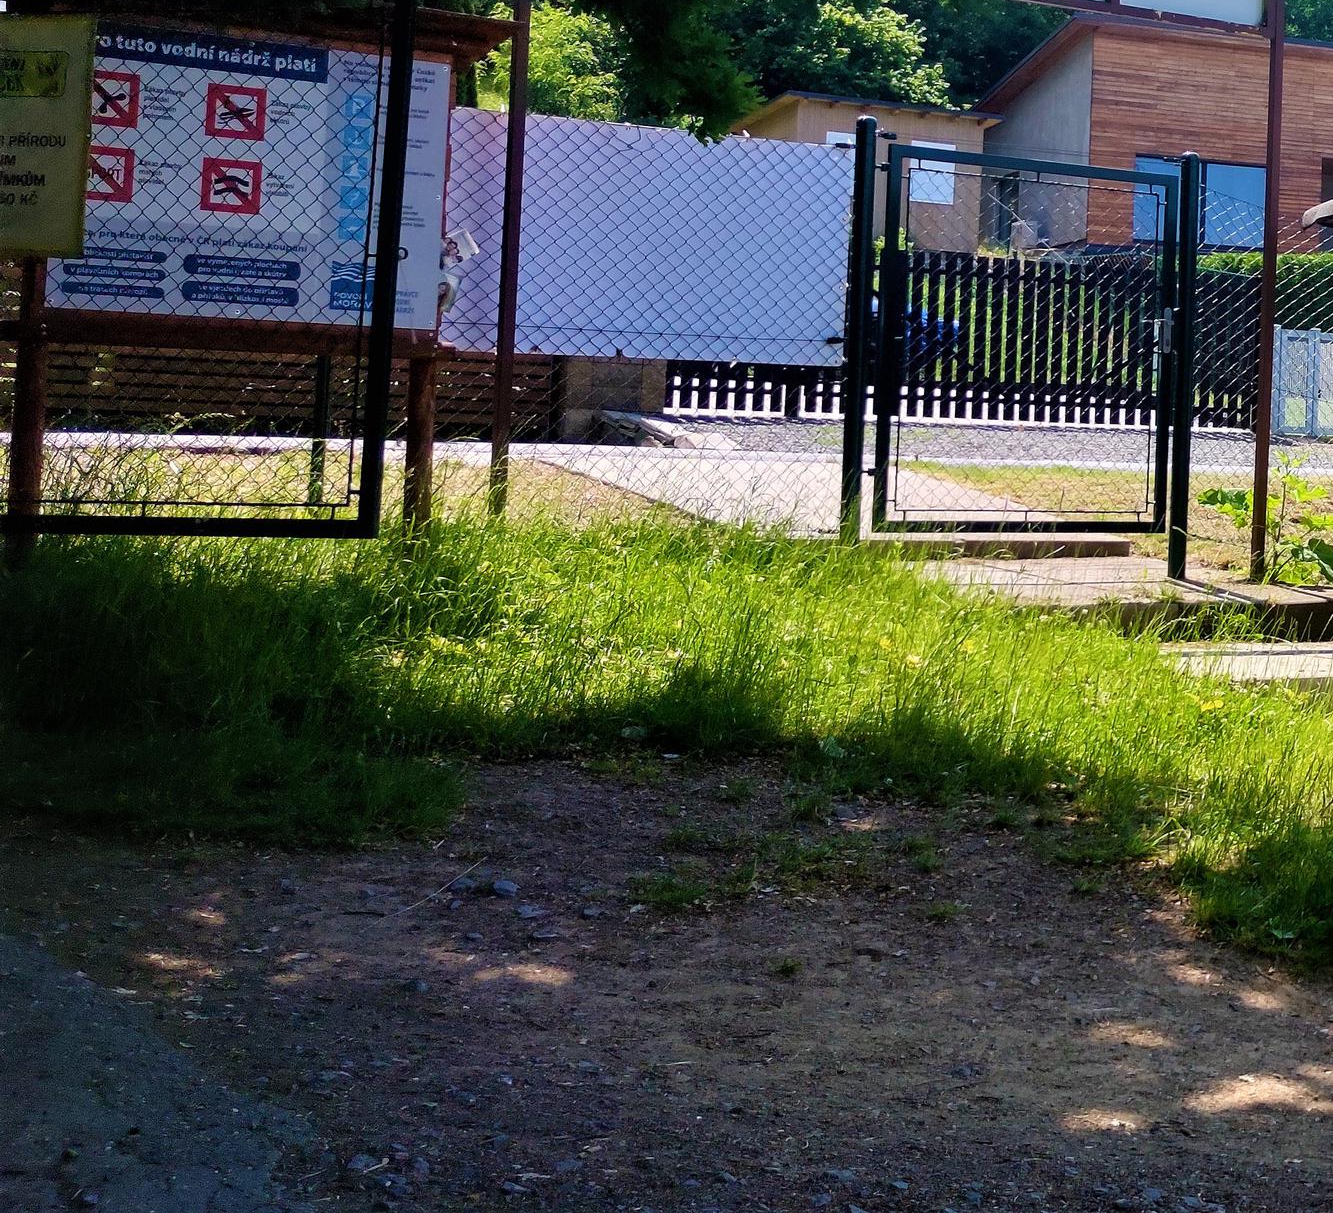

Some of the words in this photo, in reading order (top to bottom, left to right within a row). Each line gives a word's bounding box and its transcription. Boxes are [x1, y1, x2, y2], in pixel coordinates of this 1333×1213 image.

[116, 36, 156, 53] tuto
[162, 43, 214, 61] vodní
[218, 46, 271, 67] nádrž
[275, 54, 317, 73] platí
[9, 132, 66, 147] PŘÍRODU
[149, 234, 188, 245] obecně
[197, 235, 210, 245] ČR
[267, 242, 308, 253] koupání
[333, 300, 373, 309] MORAV
